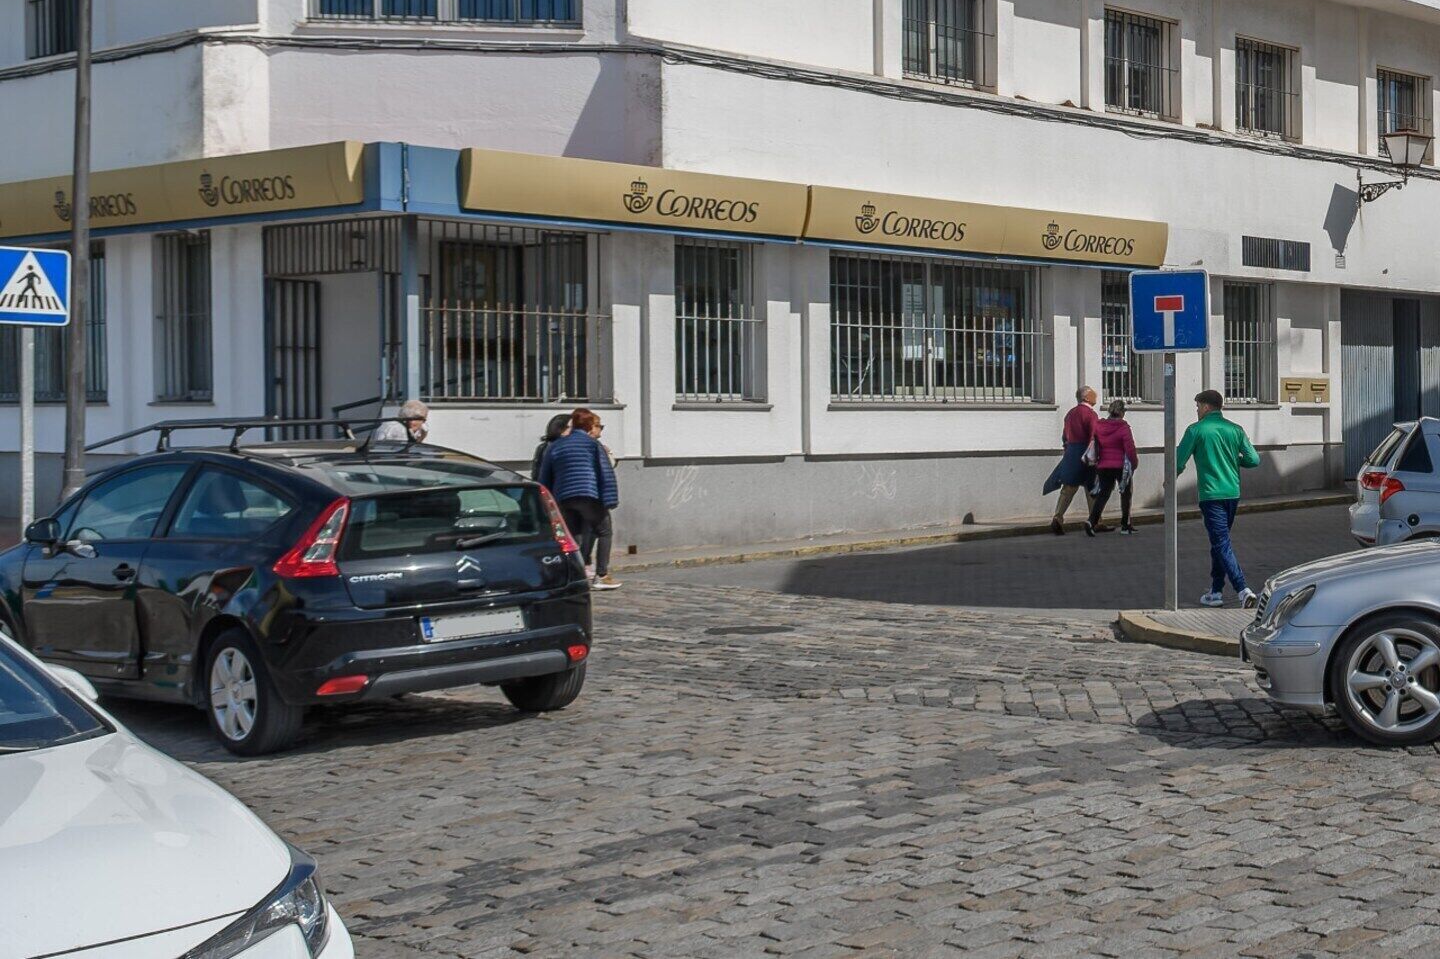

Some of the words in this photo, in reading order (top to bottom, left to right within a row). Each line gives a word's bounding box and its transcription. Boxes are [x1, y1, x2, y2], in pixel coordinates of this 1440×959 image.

[221, 175, 296, 205] CORREOS
[88, 193, 137, 218] RREOS
[656, 189, 759, 223] CORREOS
[881, 210, 967, 242] CORREOS
[1064, 229, 1135, 256] CORREOS
[542, 555, 562, 566] C4
